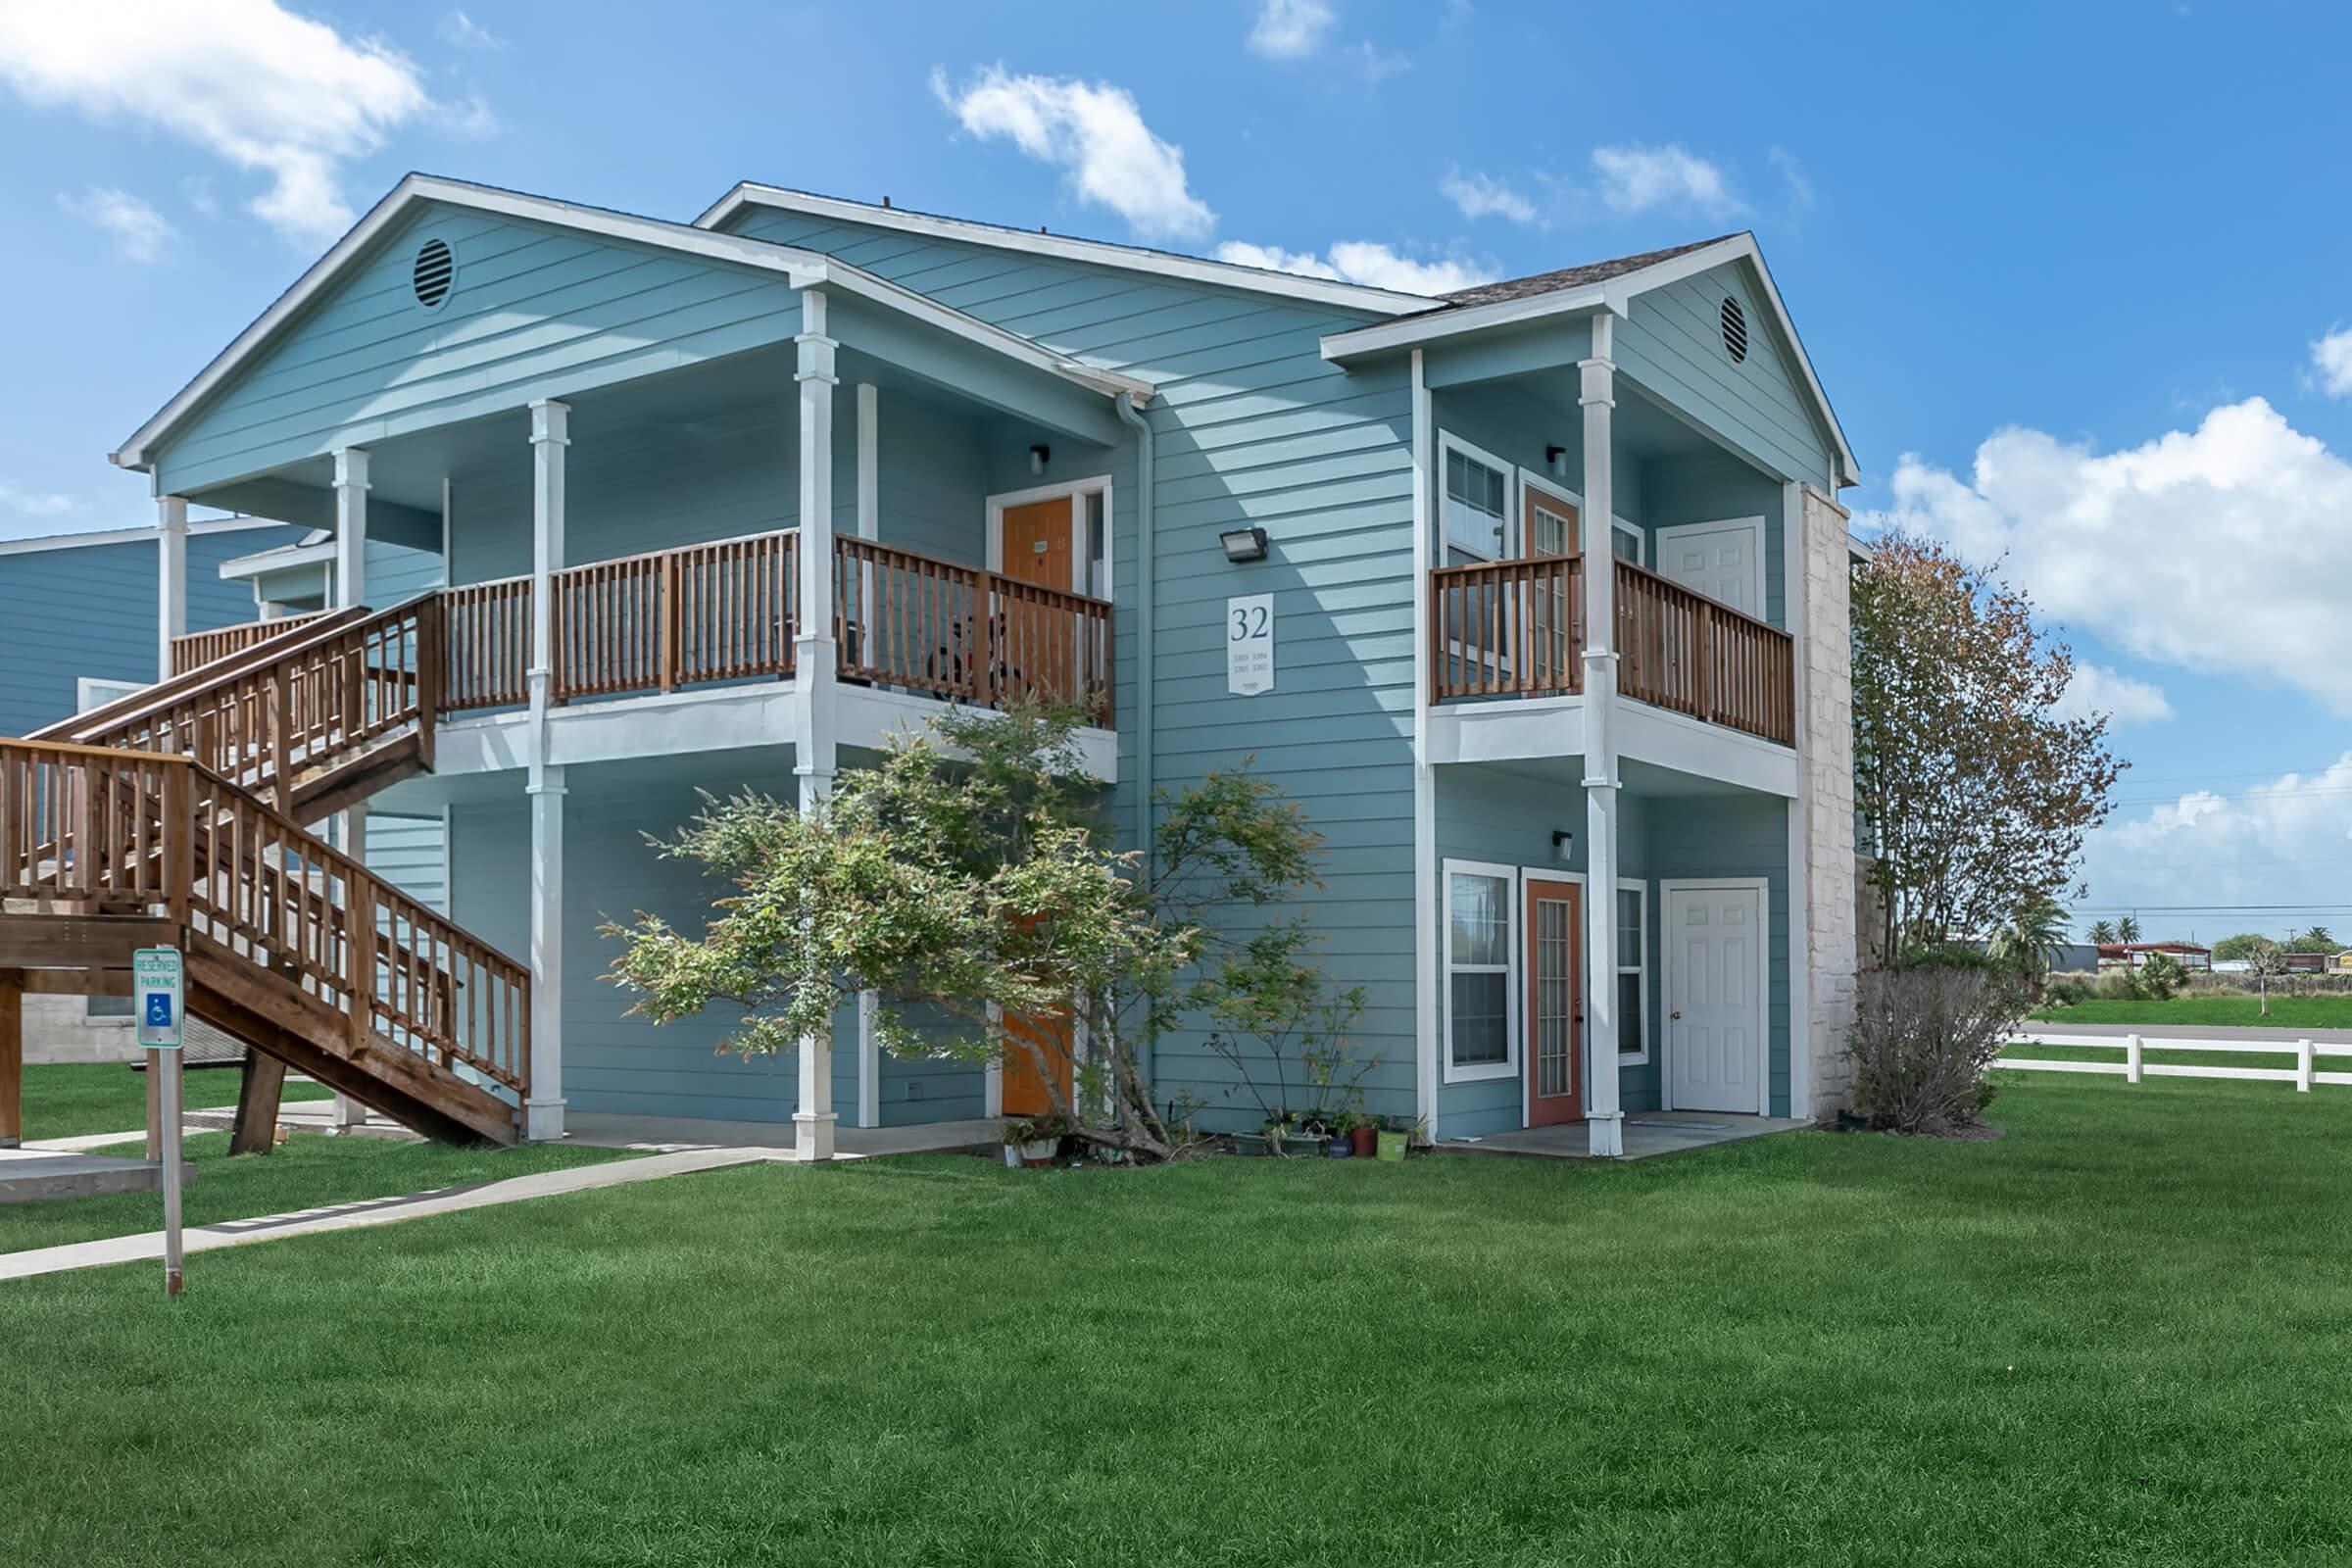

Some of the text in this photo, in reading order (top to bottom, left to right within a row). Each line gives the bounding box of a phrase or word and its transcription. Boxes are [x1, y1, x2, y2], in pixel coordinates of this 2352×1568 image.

[1231, 606, 1269, 642] 32
[135, 959, 177, 972] RESERVED
[140, 976, 176, 988] PARKING
